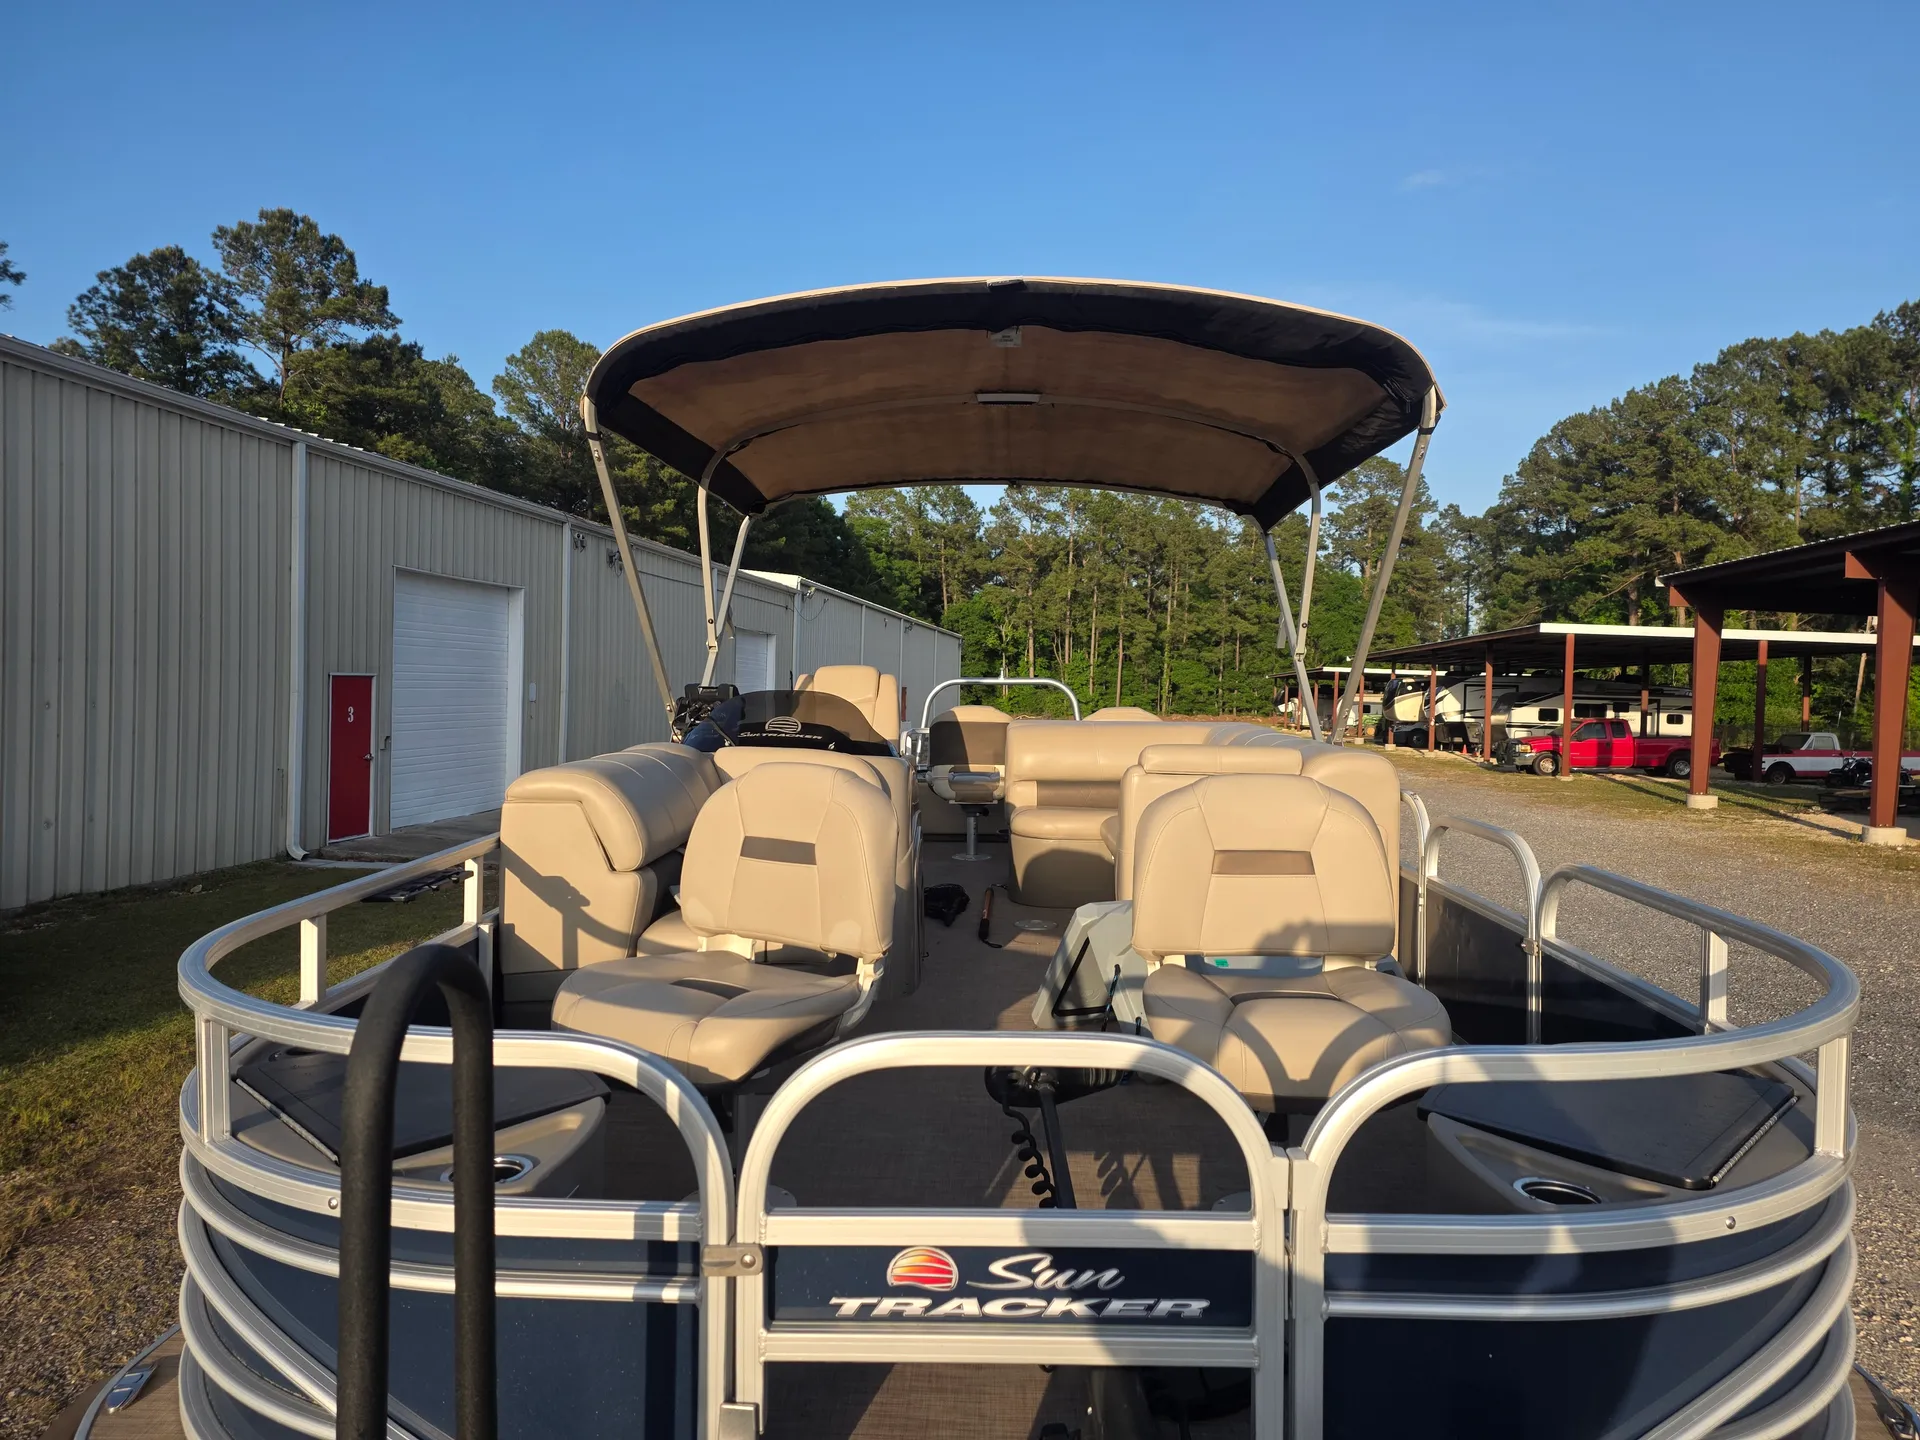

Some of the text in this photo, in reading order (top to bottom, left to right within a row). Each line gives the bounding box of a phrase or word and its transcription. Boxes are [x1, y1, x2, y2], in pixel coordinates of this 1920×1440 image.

[347, 706, 354, 723] 3
[761, 732, 823, 740] TRACKER
[966, 1253, 1126, 1290] Sun
[828, 1296, 1211, 1319] TRACKER
